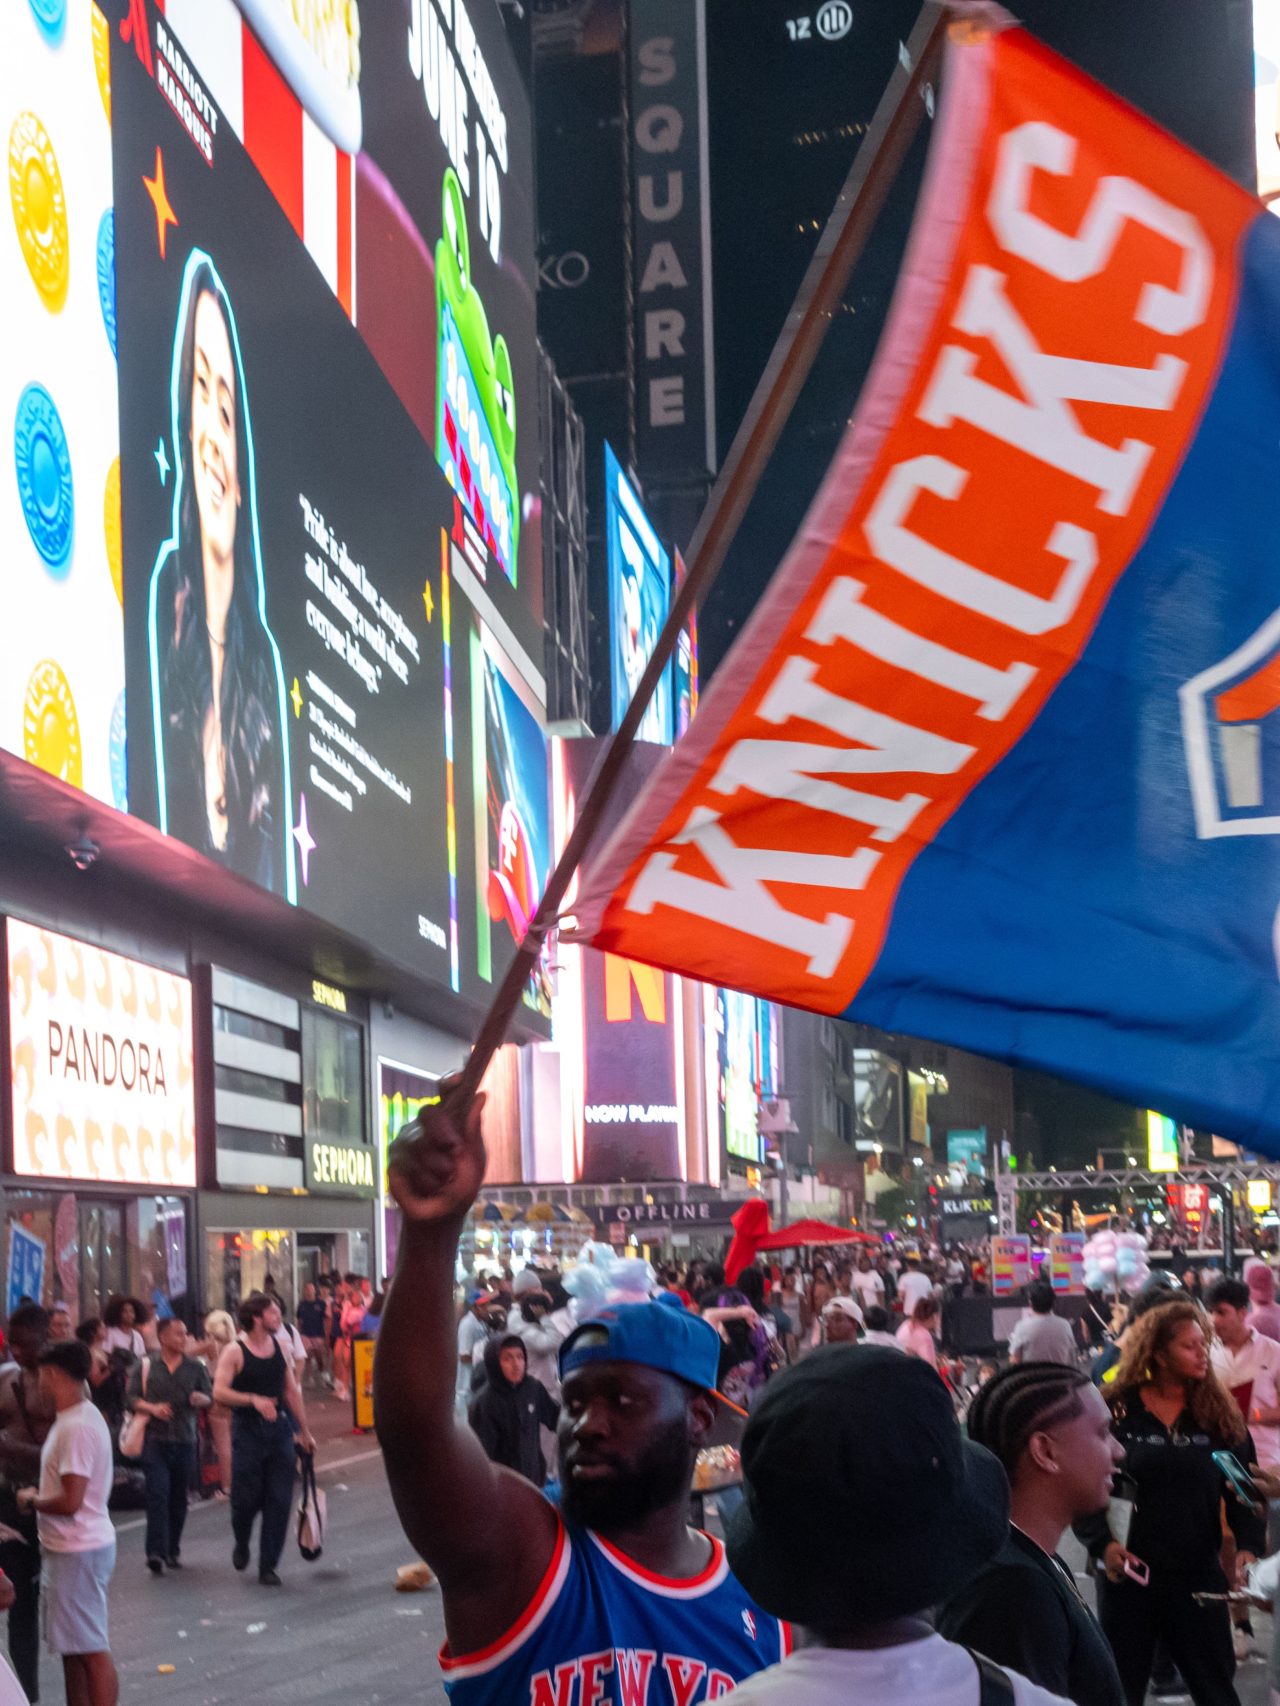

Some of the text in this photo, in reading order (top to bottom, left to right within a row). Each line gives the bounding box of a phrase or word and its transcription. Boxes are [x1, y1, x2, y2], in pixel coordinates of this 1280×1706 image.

[156, 21, 218, 135] MARRIOTT
[157, 58, 213, 161] MARQUIS
[408, 0, 501, 264] JUNE 19
[634, 37, 686, 428] SQUARE
[626, 120, 1215, 980] KNICKS
[312, 979, 347, 1013] SEPHORA
[48, 1020, 166, 1096] PANDORA
[584, 1104, 628, 1124] NOW
[312, 1142, 374, 1187] SEPHORA
[616, 1203, 710, 1222] OFFLINE
[530, 1647, 657, 1706] NEW
